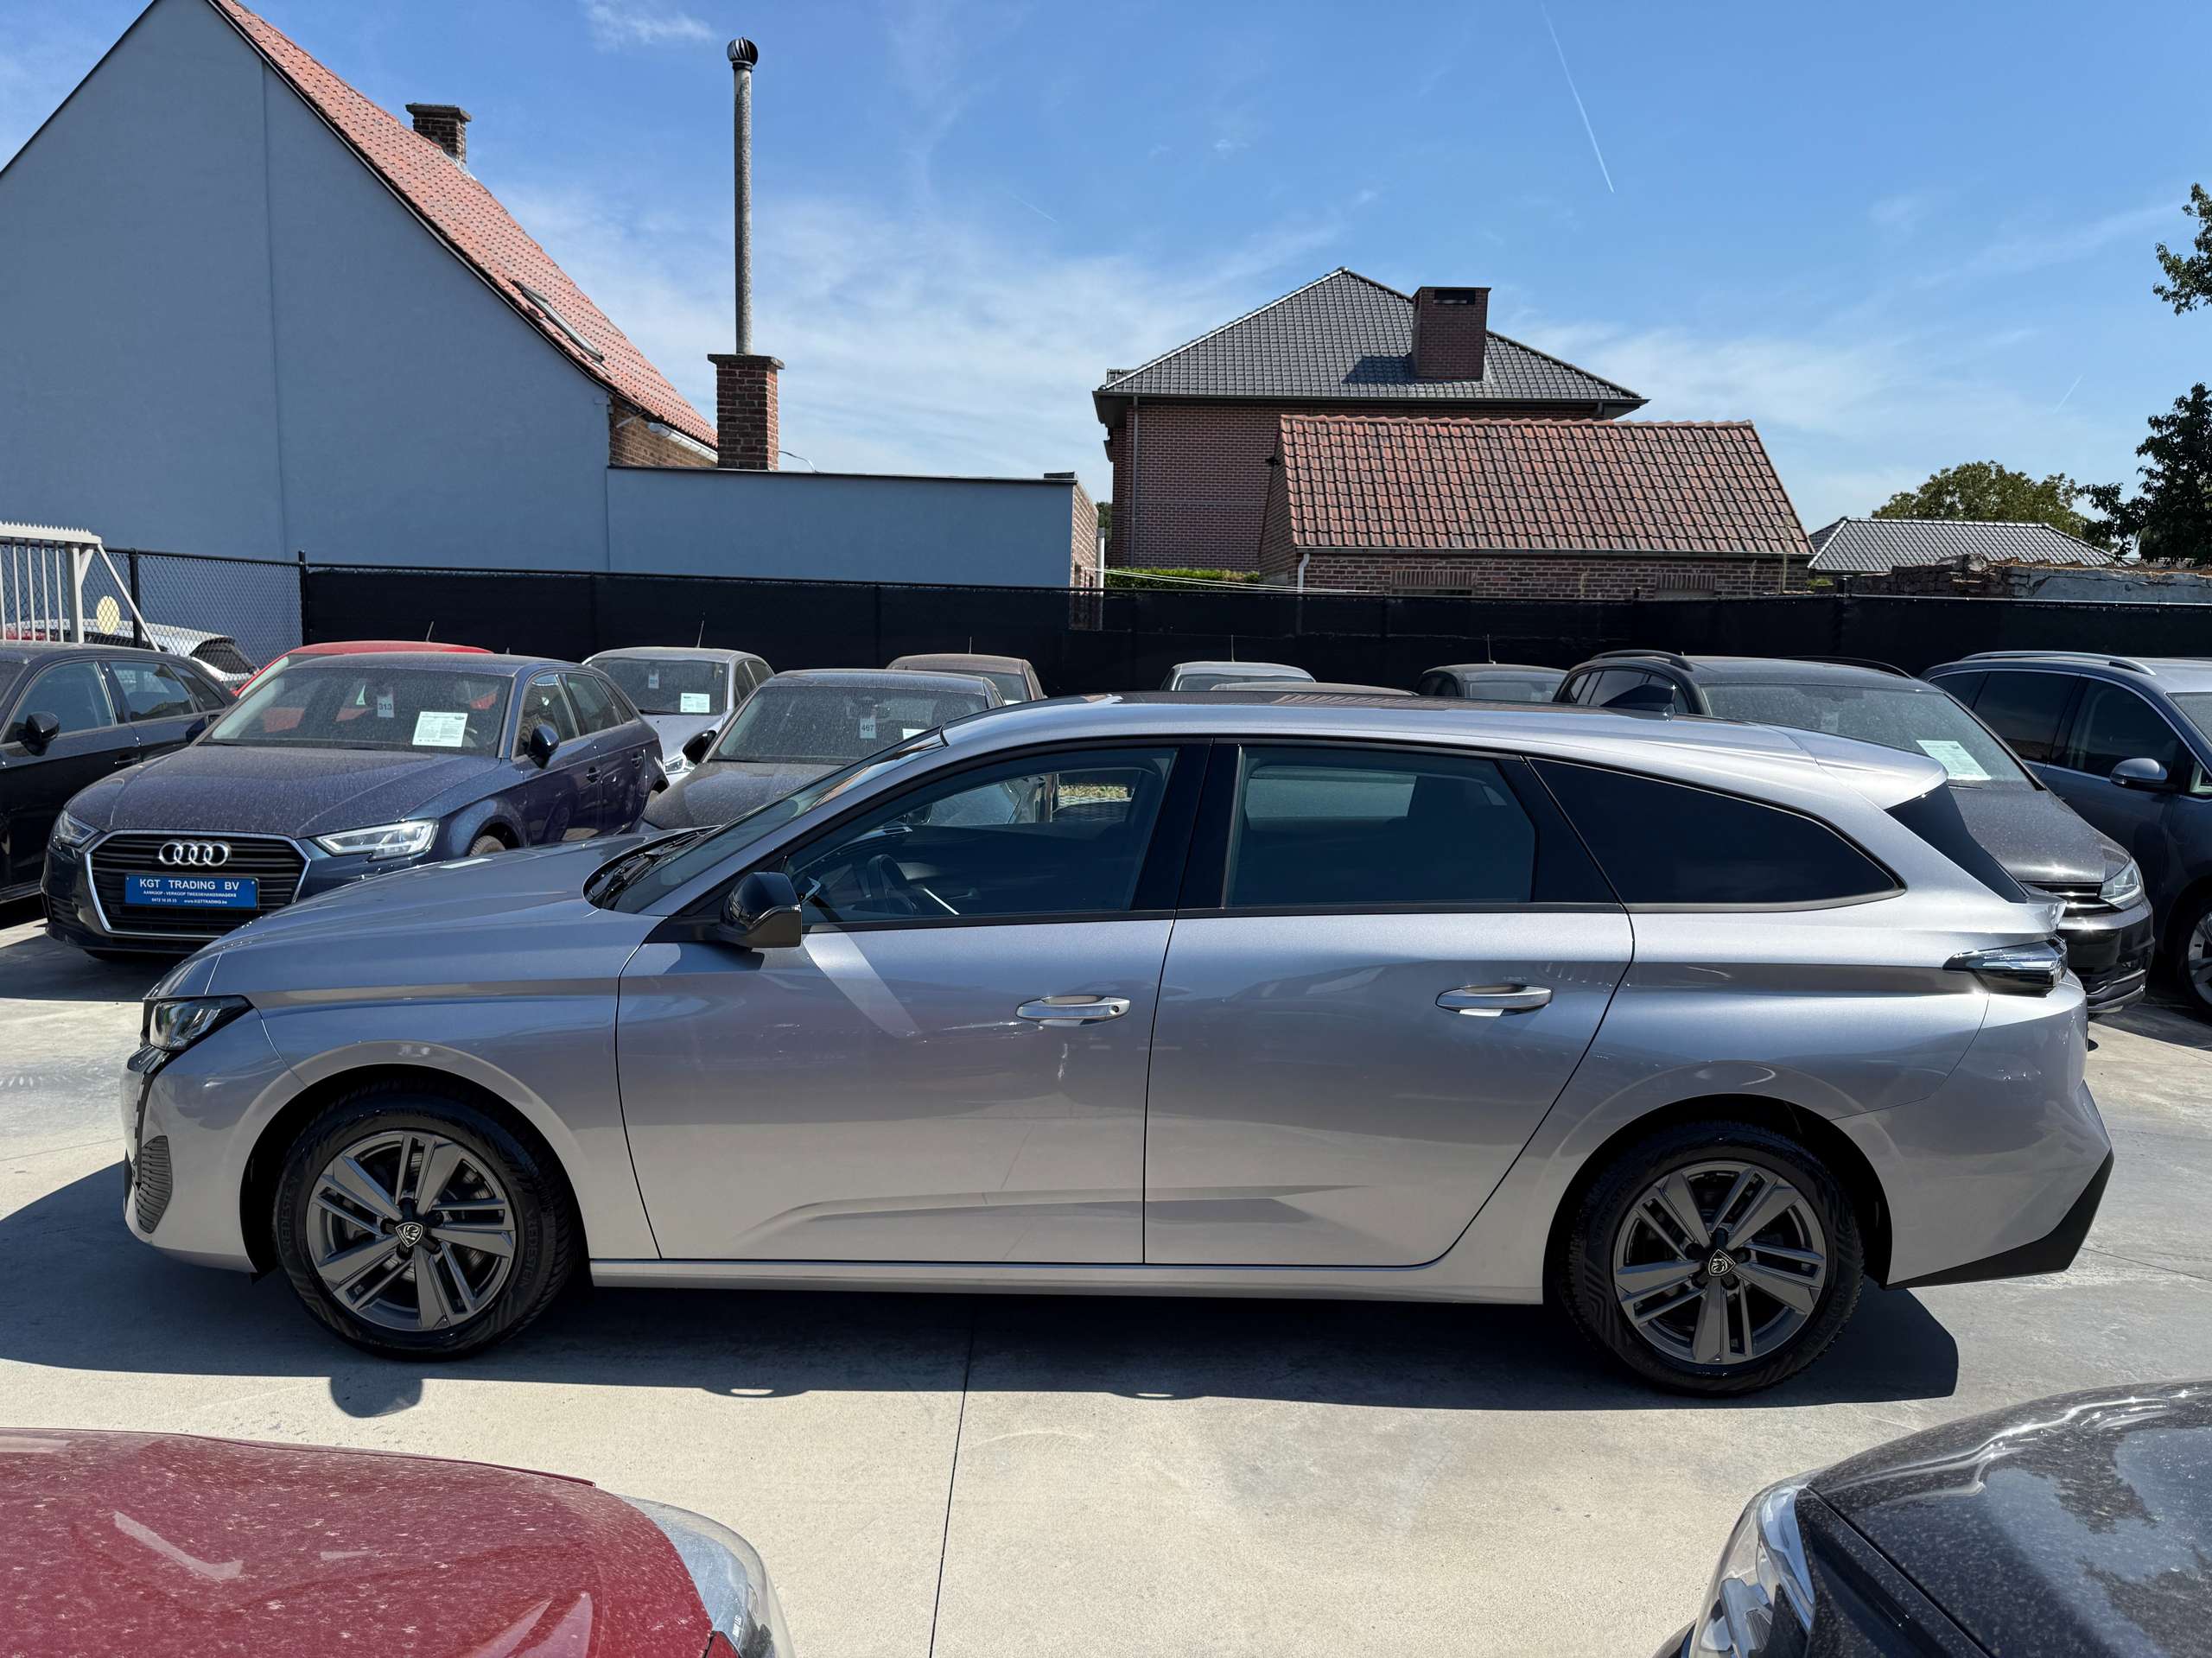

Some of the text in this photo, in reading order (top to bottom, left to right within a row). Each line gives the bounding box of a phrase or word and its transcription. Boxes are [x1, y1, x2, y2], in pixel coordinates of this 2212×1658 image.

[139, 879, 239, 891] KGT TRADING BV
